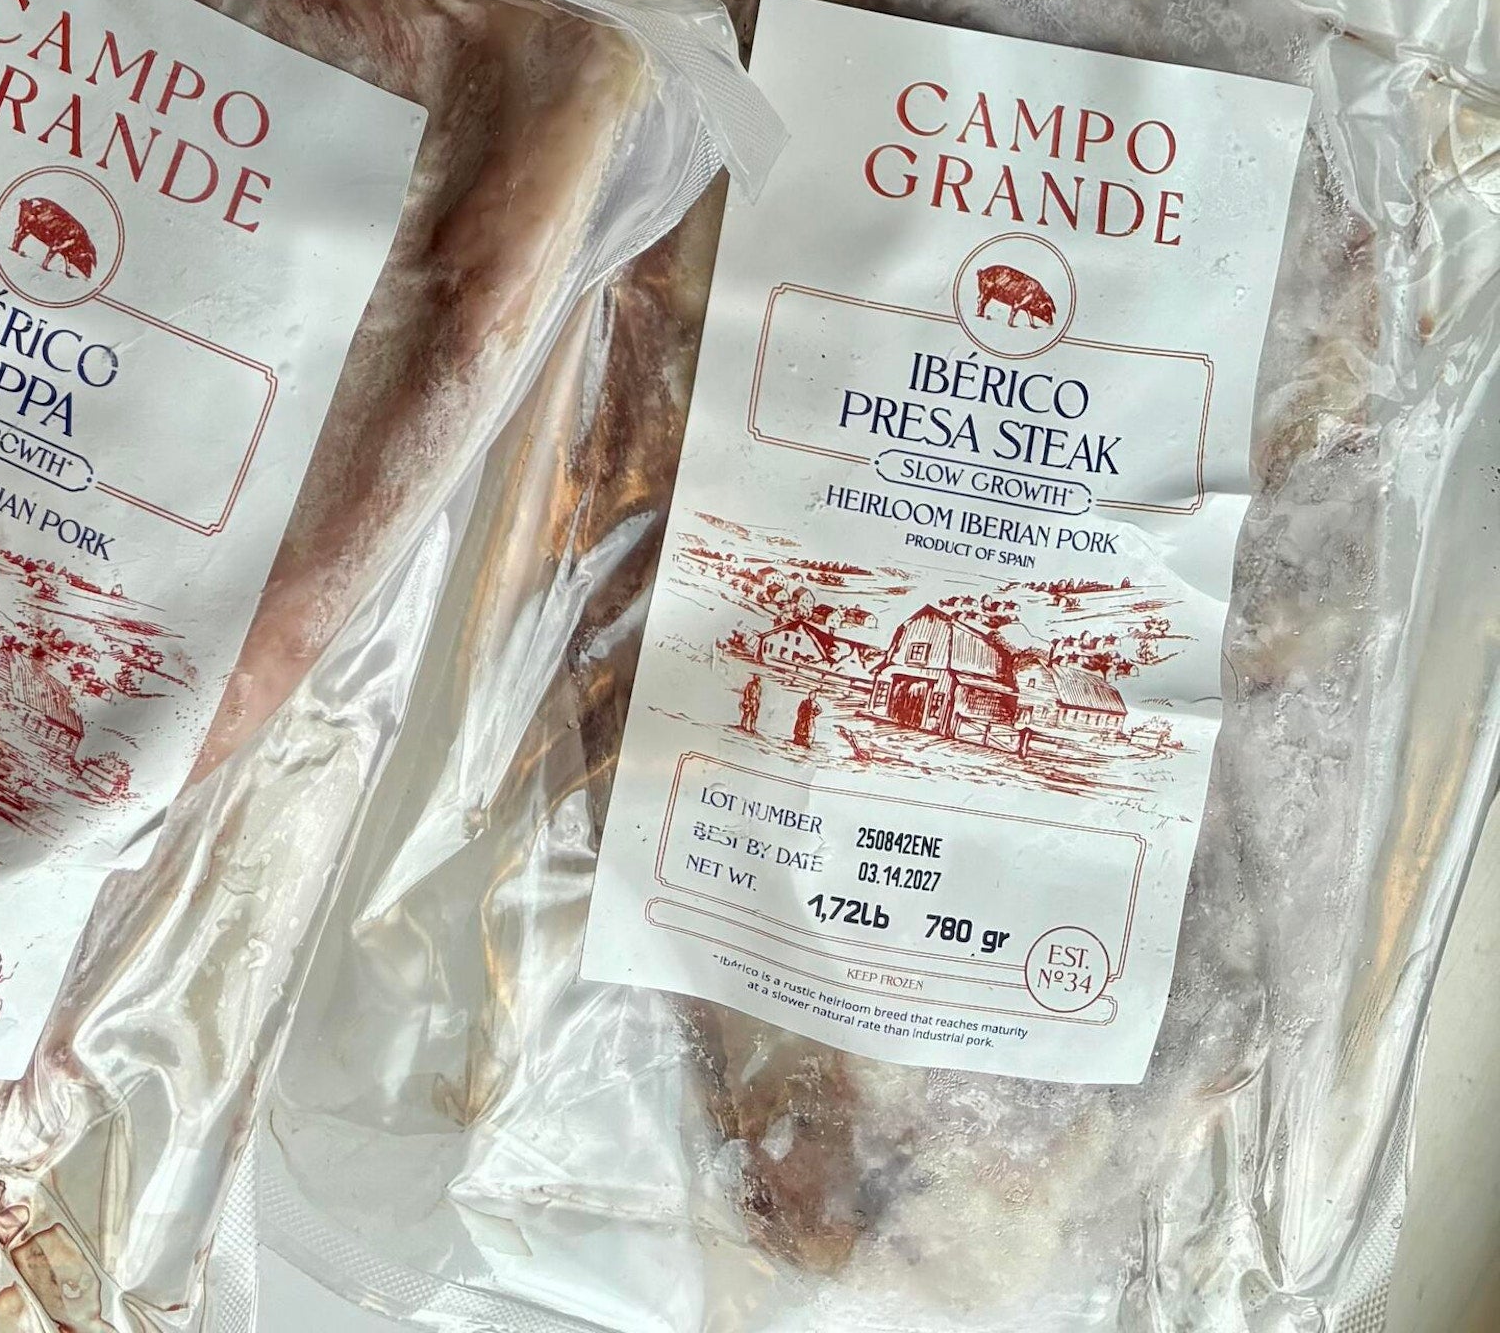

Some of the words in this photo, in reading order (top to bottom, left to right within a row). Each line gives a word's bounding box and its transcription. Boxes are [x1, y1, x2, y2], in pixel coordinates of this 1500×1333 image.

[896, 81, 1176, 175] CAMPO
[864, 144, 1184, 246] GRANDE
[908, 351, 1089, 419] IBÉRICO
[838, 389, 980, 453] PRESA
[992, 419, 1122, 475] STEAK
[38, 508, 115, 561] PORK
[826, 484, 953, 530] HEIRLOOM
[959, 511, 1051, 547] IBERIAN
[1055, 528, 1119, 554] PORK
[904, 532, 973, 557] PRODUCT
[974, 546, 996, 561] OF
[997, 550, 1035, 568] SPAIN
[700, 787, 738, 811] LOT
[741, 801, 822, 834] NUMBER
[855, 826, 943, 859] 250842ENE
[746, 837, 772, 859] BY
[775, 846, 822, 872] DATE
[857, 861, 942, 892] 03.14.2027
[925, 913, 973, 943] 780
[980, 929, 1010, 954] gr
